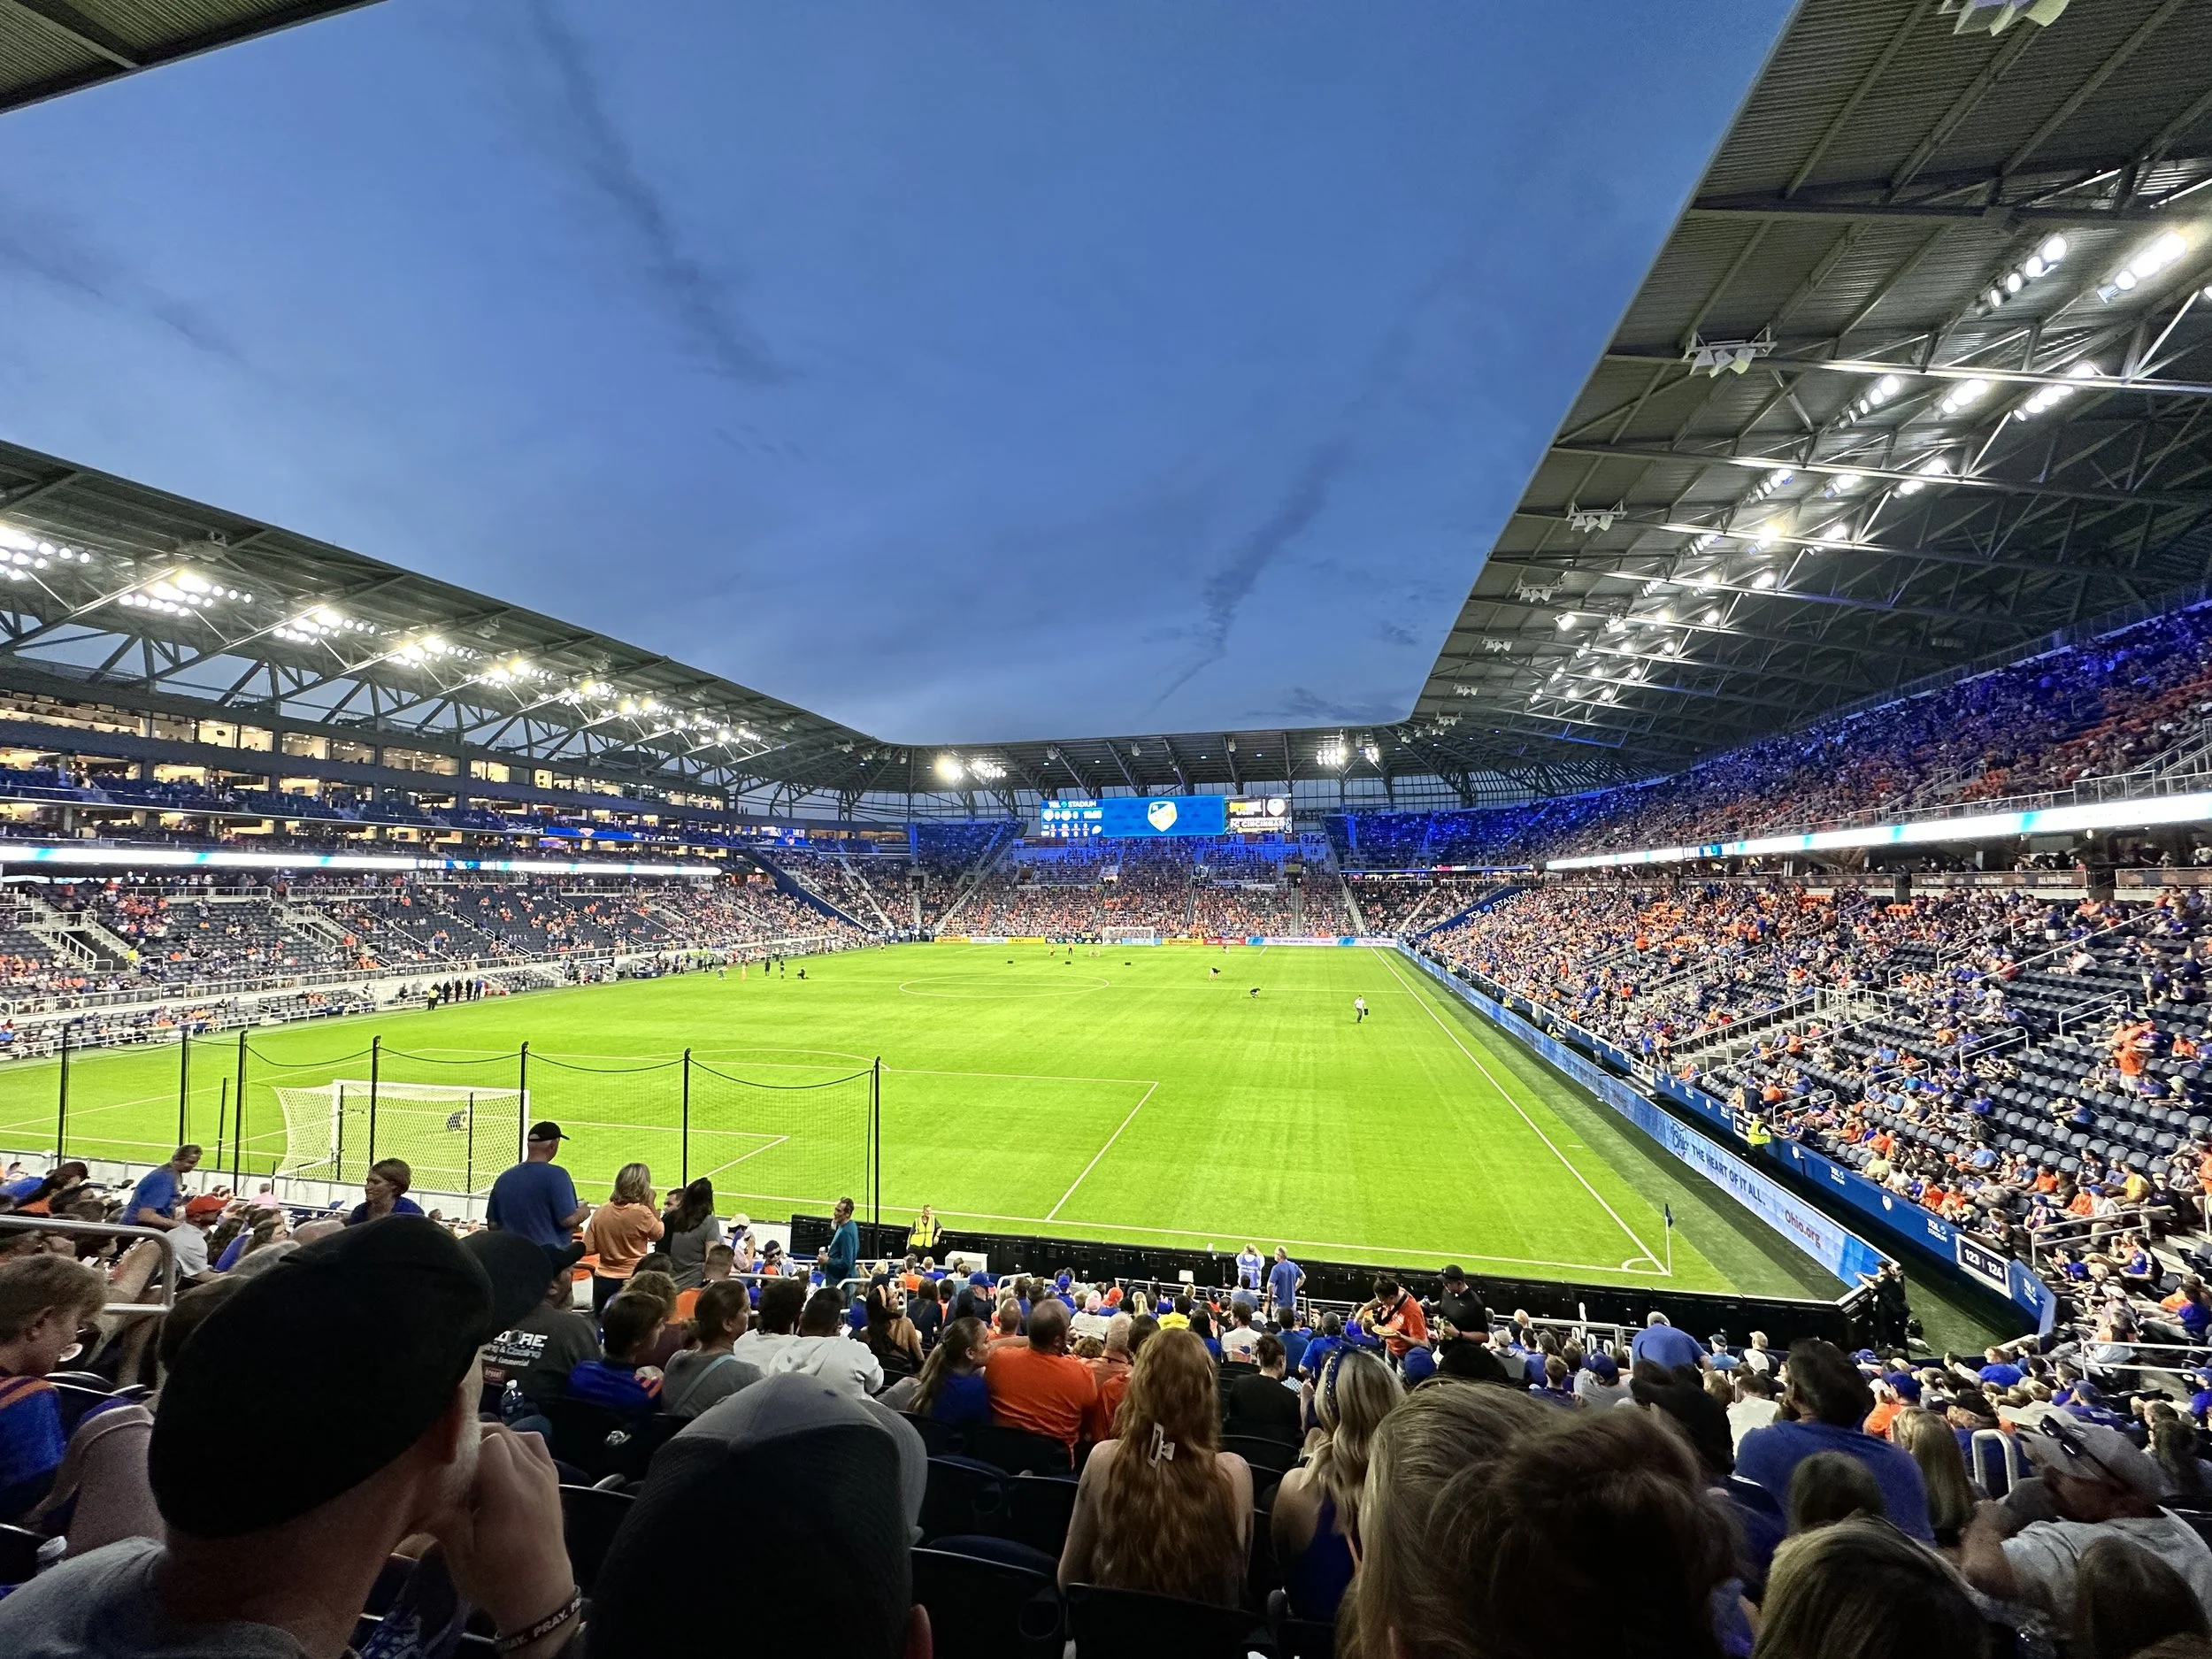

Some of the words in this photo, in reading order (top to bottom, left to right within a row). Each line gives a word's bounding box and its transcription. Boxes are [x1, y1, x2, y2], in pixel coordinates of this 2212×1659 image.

[1466, 910, 1485, 919] TQL
[1493, 887, 1532, 910] STADIUM
[1692, 1144, 1705, 1163] THE
[1706, 1153, 1728, 1178] HEART
[1729, 1170, 1738, 1186] OF
[1740, 1176, 1747, 1192] IT
[1785, 1210, 1821, 1249] Ohio.org
[1927, 1218, 1939, 1232] TQL
[1927, 1226, 1947, 1242] STADIUM
[1964, 1248, 1980, 1266] 123
[1986, 1261, 2003, 1279] 124
[498, 1357, 530, 1367] Commercial
[506, 1347, 541, 1359] Cooling
[534, 1609, 568, 1638] PRAY.
